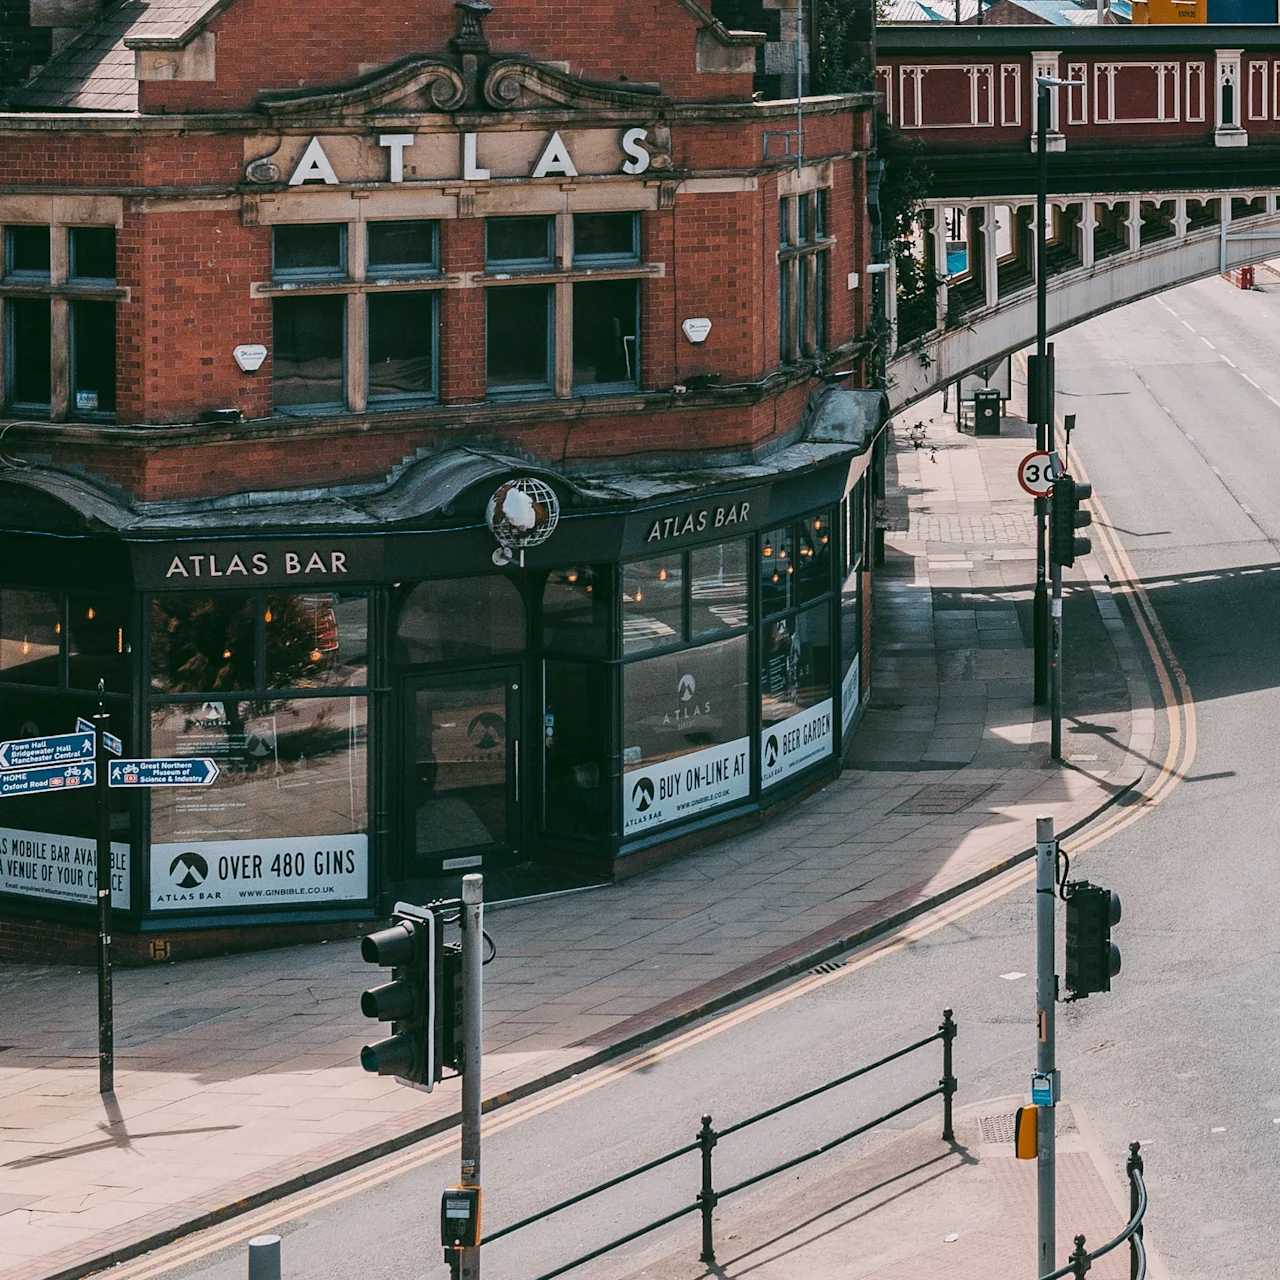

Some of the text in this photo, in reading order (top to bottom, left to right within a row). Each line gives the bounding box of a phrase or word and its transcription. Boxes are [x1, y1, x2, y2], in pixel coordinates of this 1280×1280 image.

[288, 127, 650, 186] ATLAS
[647, 502, 750, 542] ATLAS BAR
[165, 551, 348, 578] ATLAS BAR
[662, 701, 711, 725] ATLAS
[782, 712, 831, 756] BEER GARDEN
[11, 747, 55, 758] Bridgewater
[31, 741, 47, 749] Hall
[11, 751, 80, 765] Manchester Central
[140, 762, 193, 770] Great Northern
[182, 768, 190, 776] of
[3, 773, 28, 782] HOME
[140, 775, 203, 785] Science & Industry
[660, 752, 746, 801] BUY ON-LINE AT
[3, 780, 49, 791] Oxford Road
[624, 811, 662, 828] ATLAS BAR
[12, 839, 47, 860] MOBILE
[51, 844, 70, 863] BAR
[74, 847, 126, 871] AVAIBLE
[7, 859, 38, 880] VENUE
[41, 864, 54, 881] OF
[57, 866, 83, 886] YOUR
[218, 849, 355, 881] OVER 480 GINS
[156, 891, 222, 903] ATLAS BAR
[238, 886, 335, 898] WWW.GINBIBLE.CO.UK
